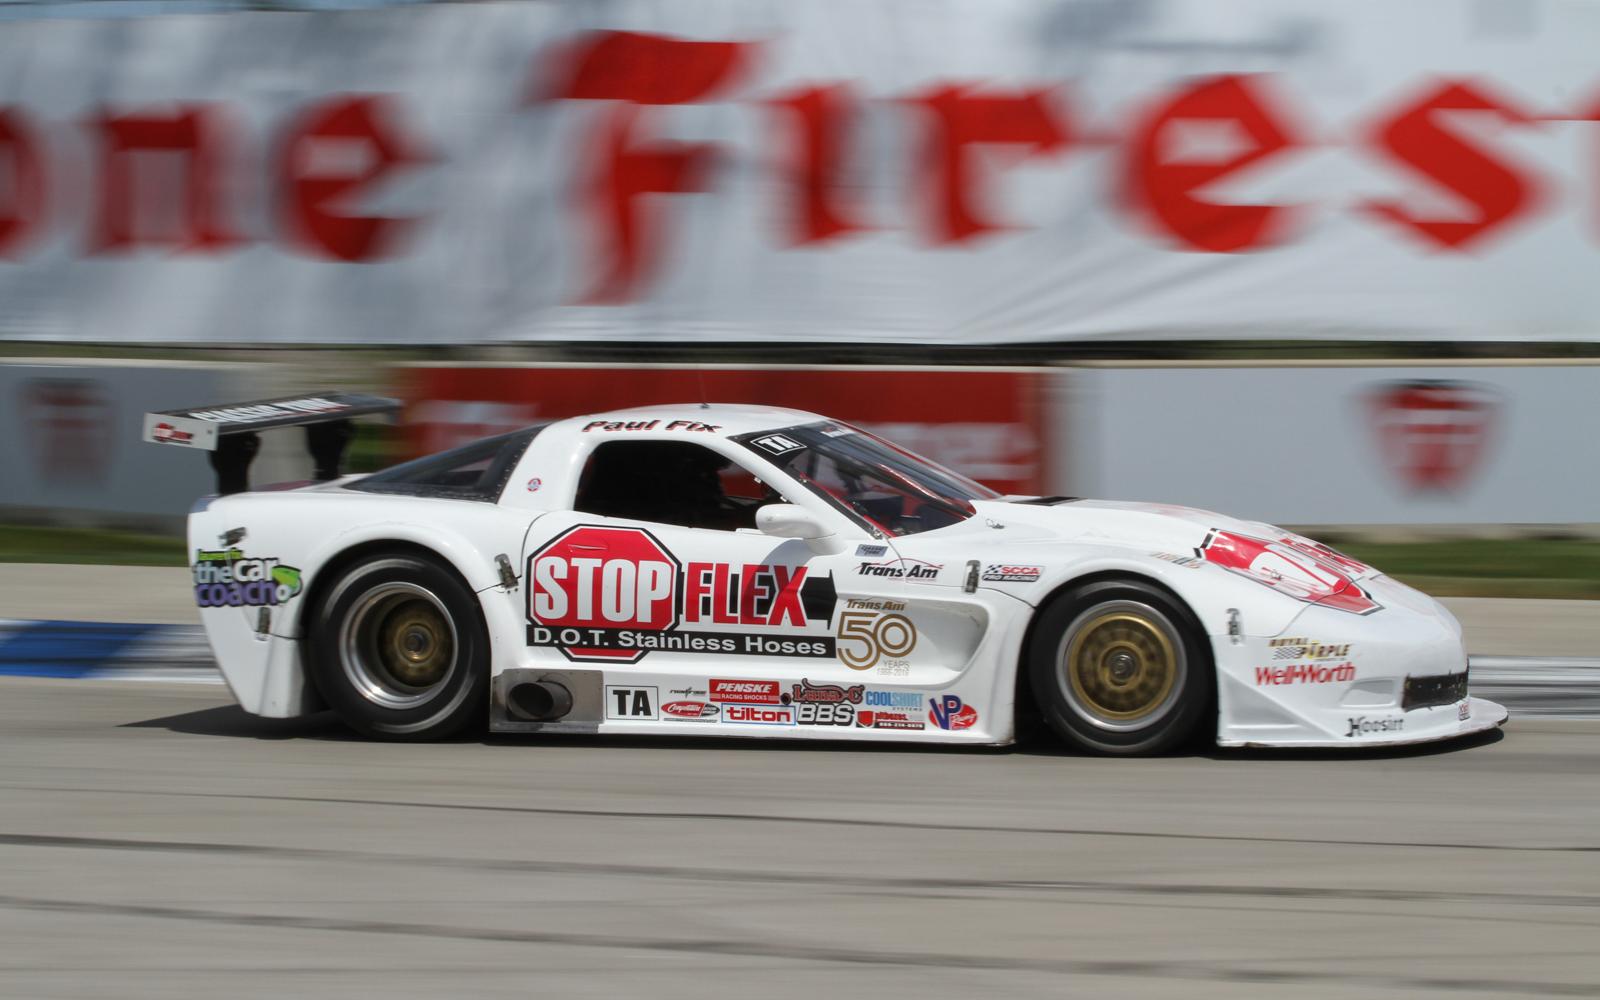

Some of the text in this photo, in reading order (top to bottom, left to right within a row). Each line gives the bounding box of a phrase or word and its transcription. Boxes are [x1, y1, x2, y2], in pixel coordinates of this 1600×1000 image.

[525, 30, 1600, 306] Fires
[582, 419, 722, 433] Paul Fix
[756, 435, 798, 452] TA
[859, 562, 939, 579] Trans Am
[1002, 566, 1040, 575] SCCA
[534, 556, 809, 627] STOP FLEX
[846, 598, 907, 611] Trans Am
[533, 627, 827, 655] D.O.T. Stainless Hoses
[838, 611, 917, 671] 50
[716, 682, 773, 693] PENSKE
[612, 689, 652, 716] TA
[929, 695, 962, 730] VP
[726, 706, 791, 722] tilton
[798, 702, 854, 725] BBS
